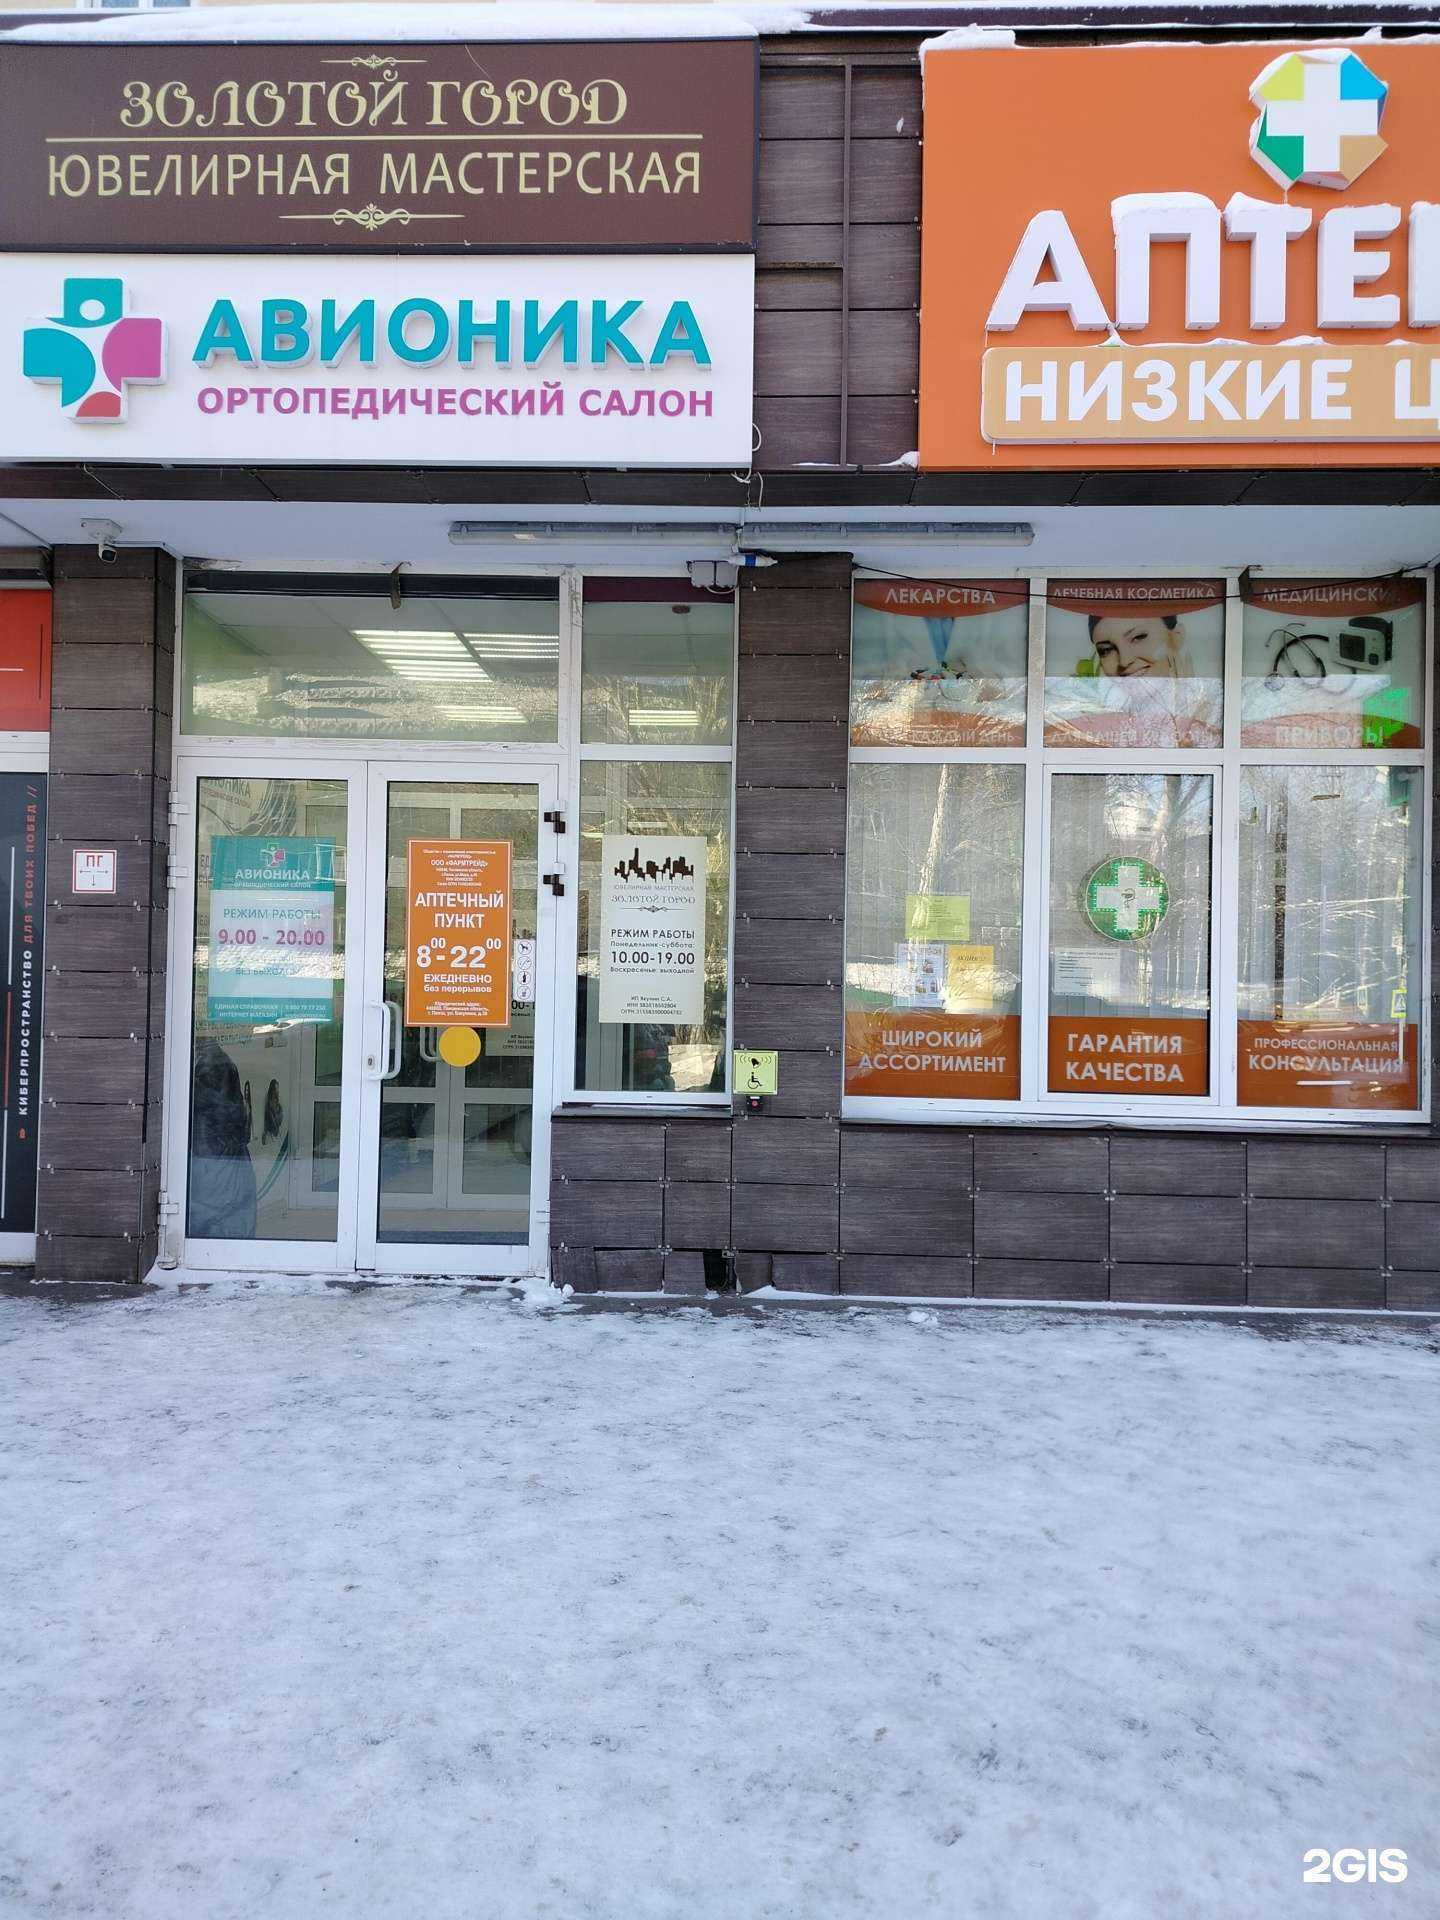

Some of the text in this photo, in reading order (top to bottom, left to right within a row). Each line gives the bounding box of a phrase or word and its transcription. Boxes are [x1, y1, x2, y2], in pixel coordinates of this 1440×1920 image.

[119, 69, 628, 127] ЗОЛОТОЙ ГОРОД
[48, 151, 701, 197] ЮВЕЛИРНАЯ МАСТЕРСКАЯ
[192, 298, 712, 371] АВИОНИКА
[1006, 359, 1352, 422] НИЗКИЕ
[198, 381, 714, 420] ОРТОПЕДИЧЕСКИЙ САЛОН
[885, 588, 996, 604] ЛЕКАРСТВА
[1053, 586, 1216, 600] ЛЕЧЕБНАЯ КОСМЕТИКА
[26, 804, 37, 853] ПОБЕД
[86, 855, 103, 867] ПГ
[24, 859, 36, 908] ТВОИХ
[234, 868, 311, 881] АВИОНИКА
[415, 890, 504, 908] АПТЕЧНЫЙ
[223, 908, 321, 921] РЕЖИМ РАБОТЫ
[434, 913, 485, 928] ПУНКТ
[24, 915, 33, 944] ДЛЯ
[217, 929, 257, 945] 9.00
[275, 929, 326, 946] 20.00
[611, 929, 695, 939] РЕЖИМ РАБОТЫ
[611, 951, 695, 965] 10.00-19.00
[424, 973, 492, 984] ЕЖЕДНЕВНО
[19, 950, 32, 1116] КИБЕРПРОСТРАНСТВО
[882, 1028, 983, 1048] ШИРОКИЙ
[1067, 1033, 1182, 1054] ГАРАНТИЯ
[1254, 1037, 1399, 1052] ПРОФЕССИОНАЛЬНАЯ
[859, 1054, 1006, 1072] АССОРТИМЕНТ
[1066, 1061, 1184, 1082] КАЧЕСТВА
[1249, 1054, 1404, 1074] КОНСУЛЬТАЦИЯ
